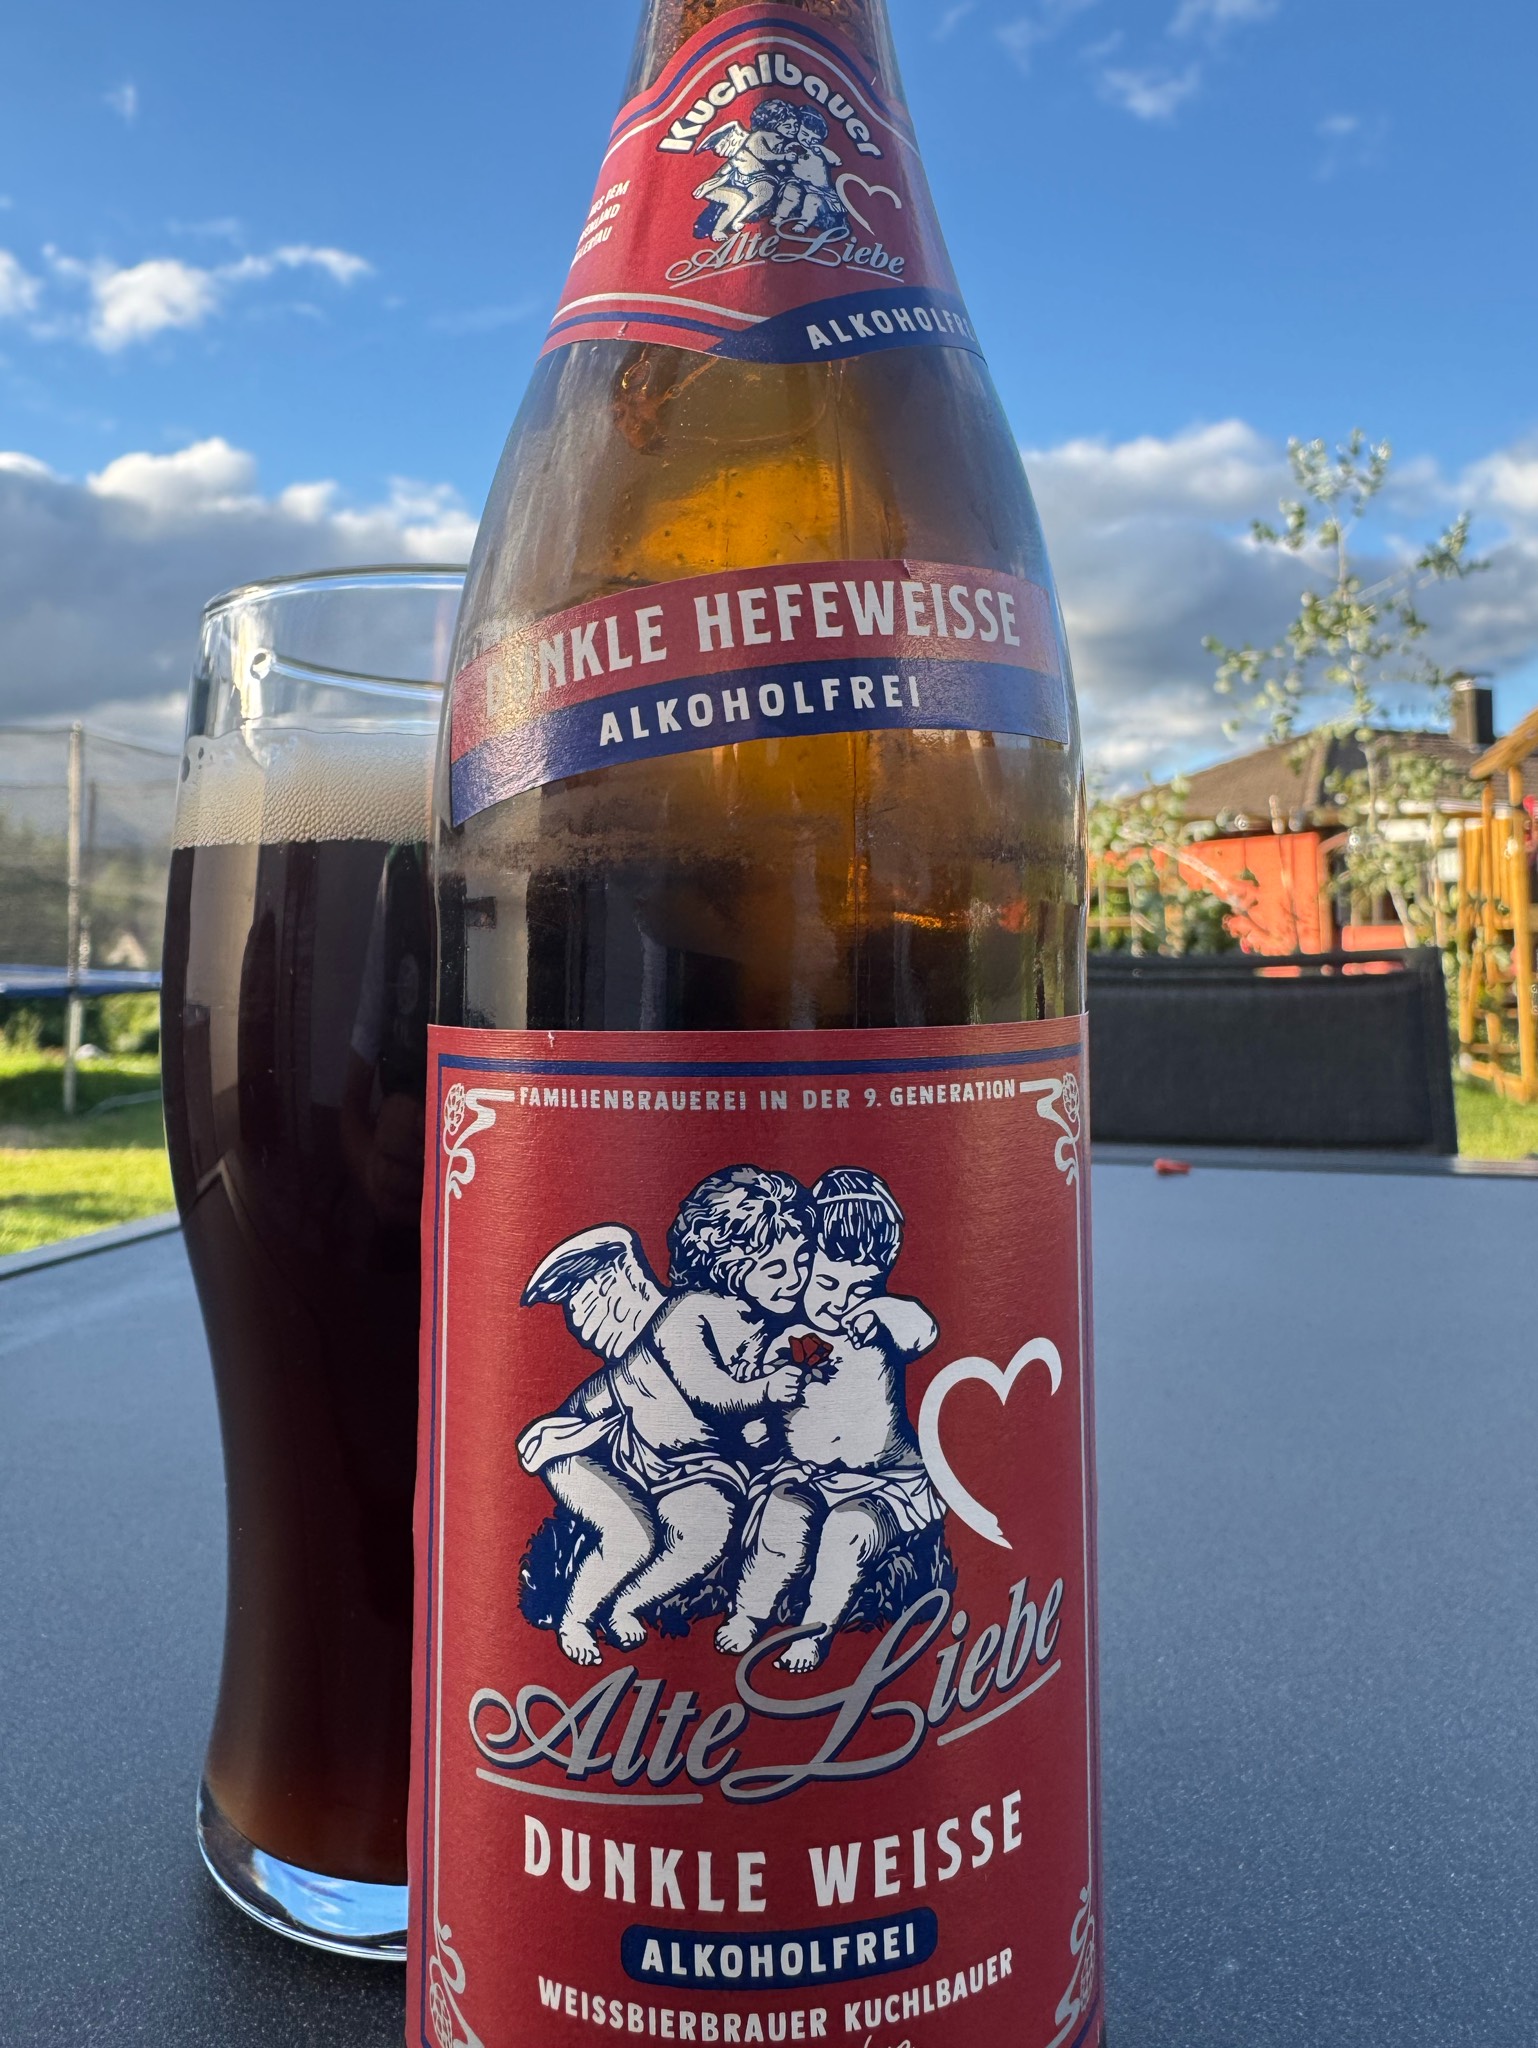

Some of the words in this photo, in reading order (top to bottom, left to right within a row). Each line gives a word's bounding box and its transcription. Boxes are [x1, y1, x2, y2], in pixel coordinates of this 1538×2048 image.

[658, 53, 881, 158] Kuchlbauer
[666, 230, 777, 281] Alte
[772, 218, 905, 274] Liebe
[486, 604, 668, 719] NKLE
[693, 580, 1021, 653] HEFEWEISSE
[600, 674, 920, 747] ALKOHOLFREI
[520, 1086, 746, 1111] FAMILIENBRAUEREI
[760, 1090, 787, 1110] IN
[803, 1089, 850, 1110] DER
[864, 1088, 882, 1107] 9.
[890, 1079, 1015, 1106] GENERATION
[468, 1665, 750, 1786] Alte
[719, 1577, 1064, 1804] Liebe
[523, 1814, 767, 1913] DUNKLE
[808, 1790, 1023, 1907] WEISSE
[538, 1976, 828, 2042] WEISSBIERBRAUER
[844, 1947, 1014, 2033] KUCHLBAUER
[641, 1922, 916, 1978] ALKOHOLFREI
